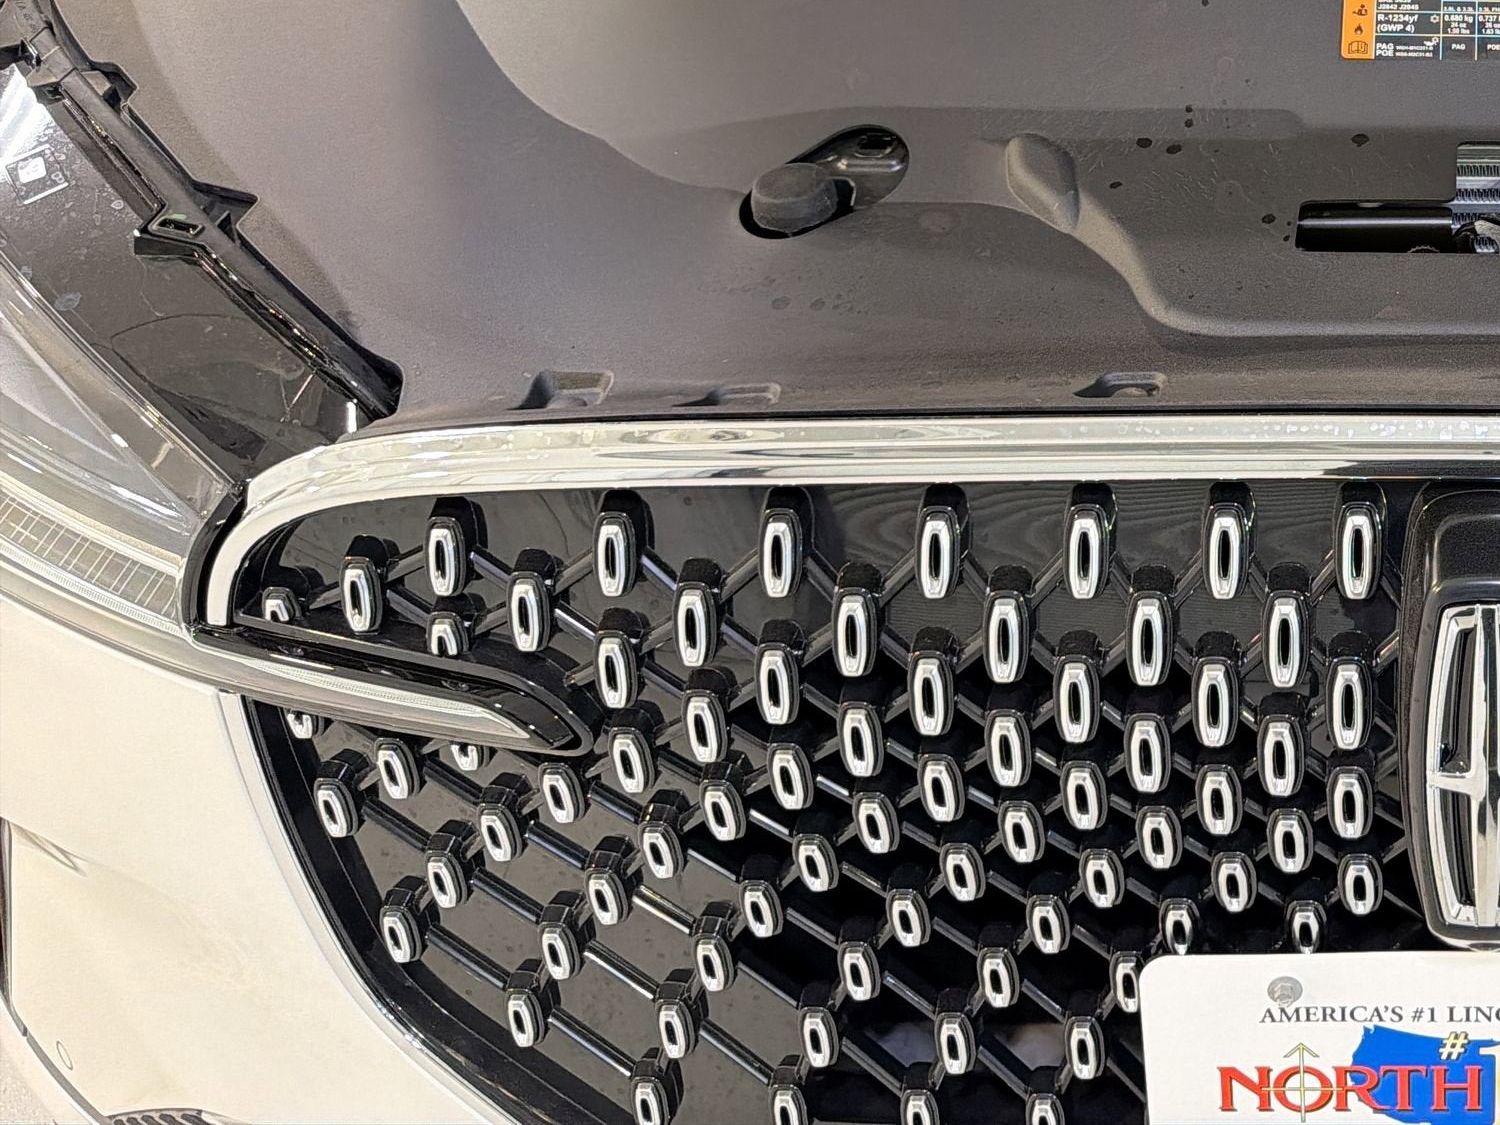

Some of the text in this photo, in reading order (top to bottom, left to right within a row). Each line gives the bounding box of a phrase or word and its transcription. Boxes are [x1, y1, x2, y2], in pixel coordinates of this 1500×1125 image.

[1378, 14, 1418, 23] R-1234yf
[1464, 15, 1473, 23] kg
[1377, 24, 1415, 32] (GWP 4)
[1411, 1005, 1439, 1023] #1
[1216, 1065, 1482, 1112] NORTH
